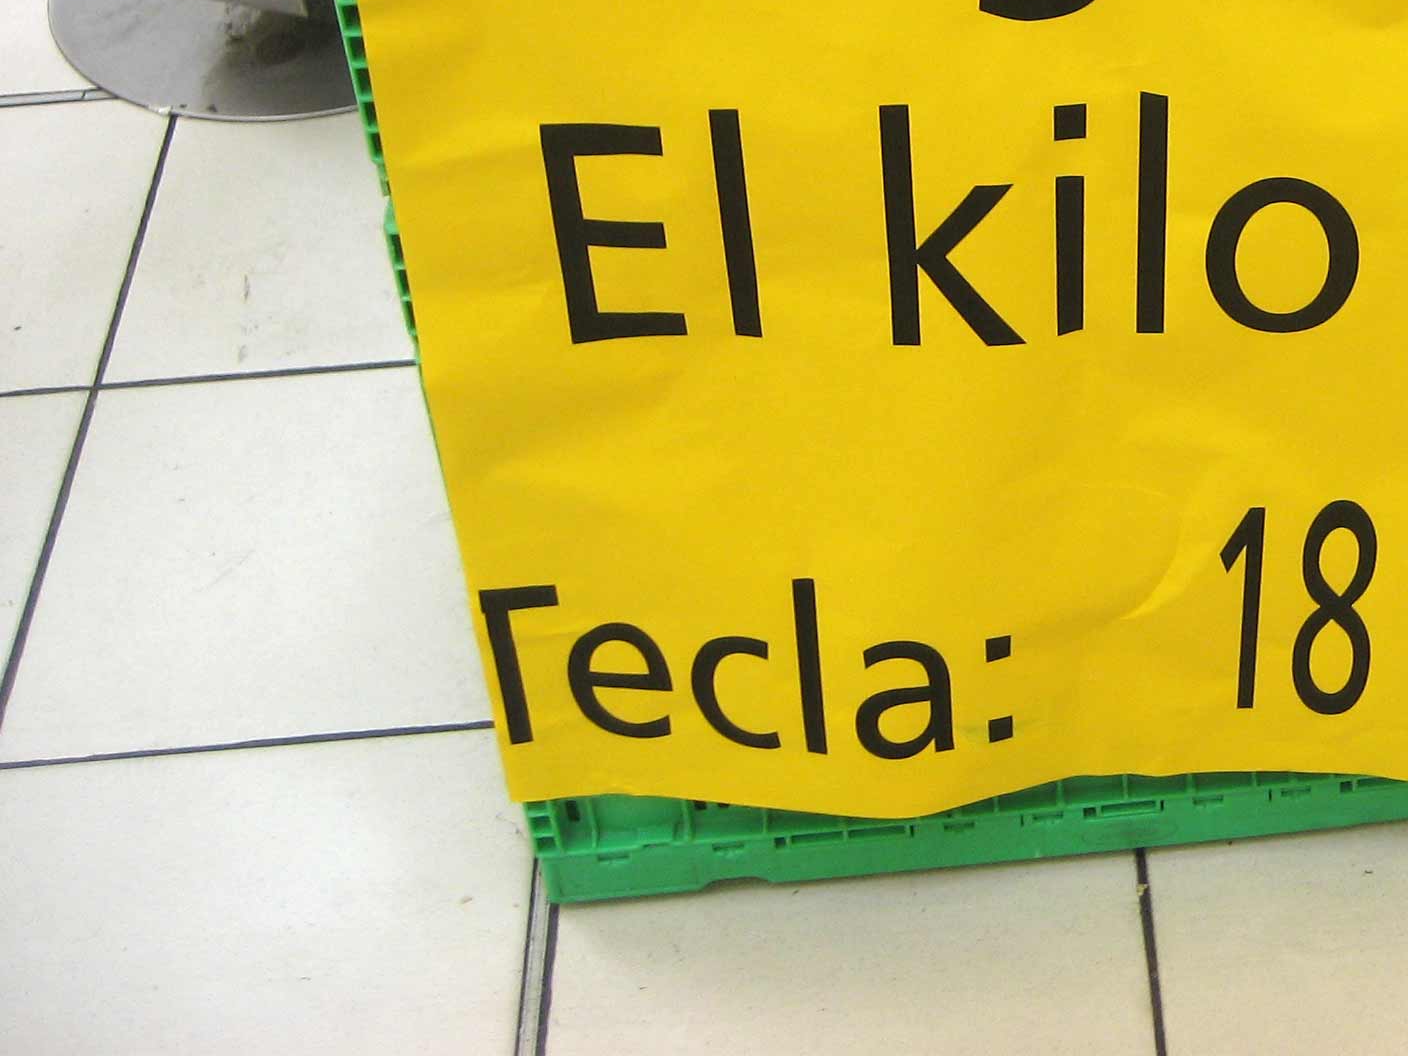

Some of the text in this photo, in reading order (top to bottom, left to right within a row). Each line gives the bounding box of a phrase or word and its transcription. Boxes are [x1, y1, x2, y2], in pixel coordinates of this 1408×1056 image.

[540, 91, 1360, 347] El kilo
[478, 499, 1378, 760] Tecla: 18
